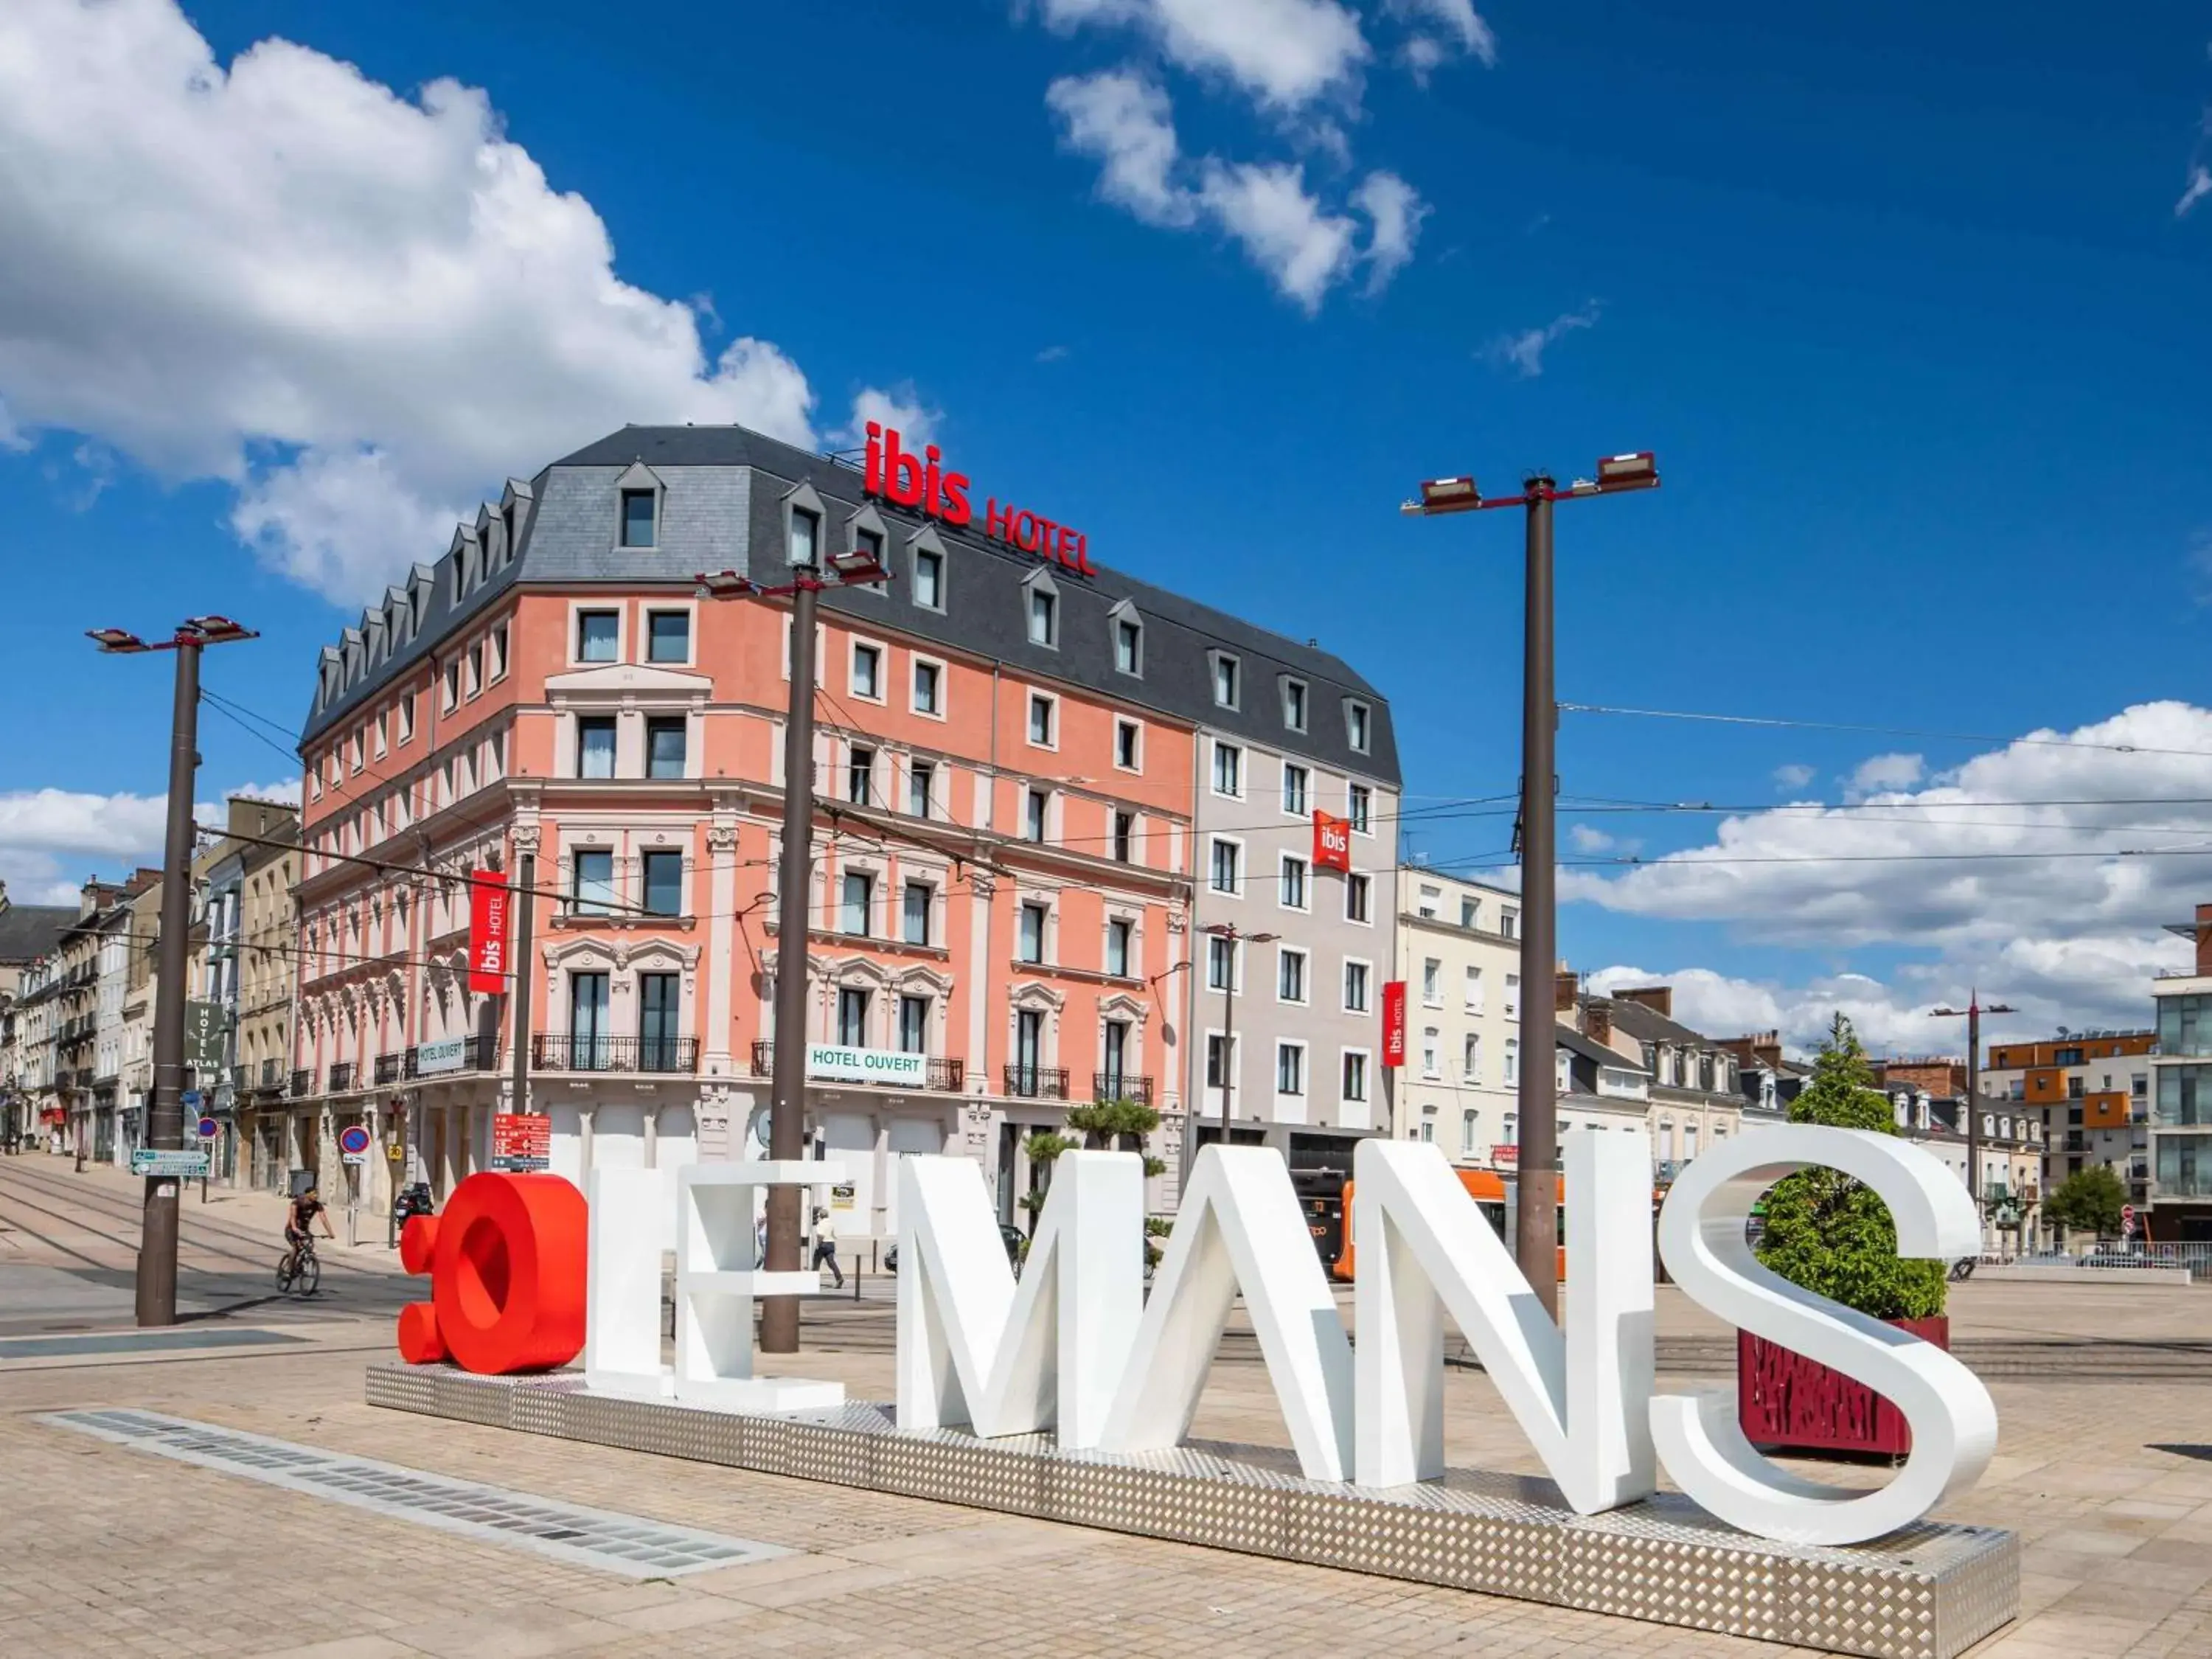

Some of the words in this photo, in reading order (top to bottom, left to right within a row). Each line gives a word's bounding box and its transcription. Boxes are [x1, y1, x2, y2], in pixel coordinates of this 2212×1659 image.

[864, 421, 971, 528] ibis
[986, 496, 1098, 577] HOTEL
[1321, 826, 1346, 852] ibis
[489, 894, 503, 936] HOTEL
[480, 940, 501, 973] ibis
[199, 1008, 210, 1057] HOTEL
[1389, 1029, 1402, 1054] ibis
[186, 1059, 220, 1068] ATLAS
[813, 1050, 860, 1068] HOTEL
[865, 1055, 920, 1073] OUVERT
[586, 1160, 846, 1412] LE
[894, 1122, 1999, 1548] MANS
